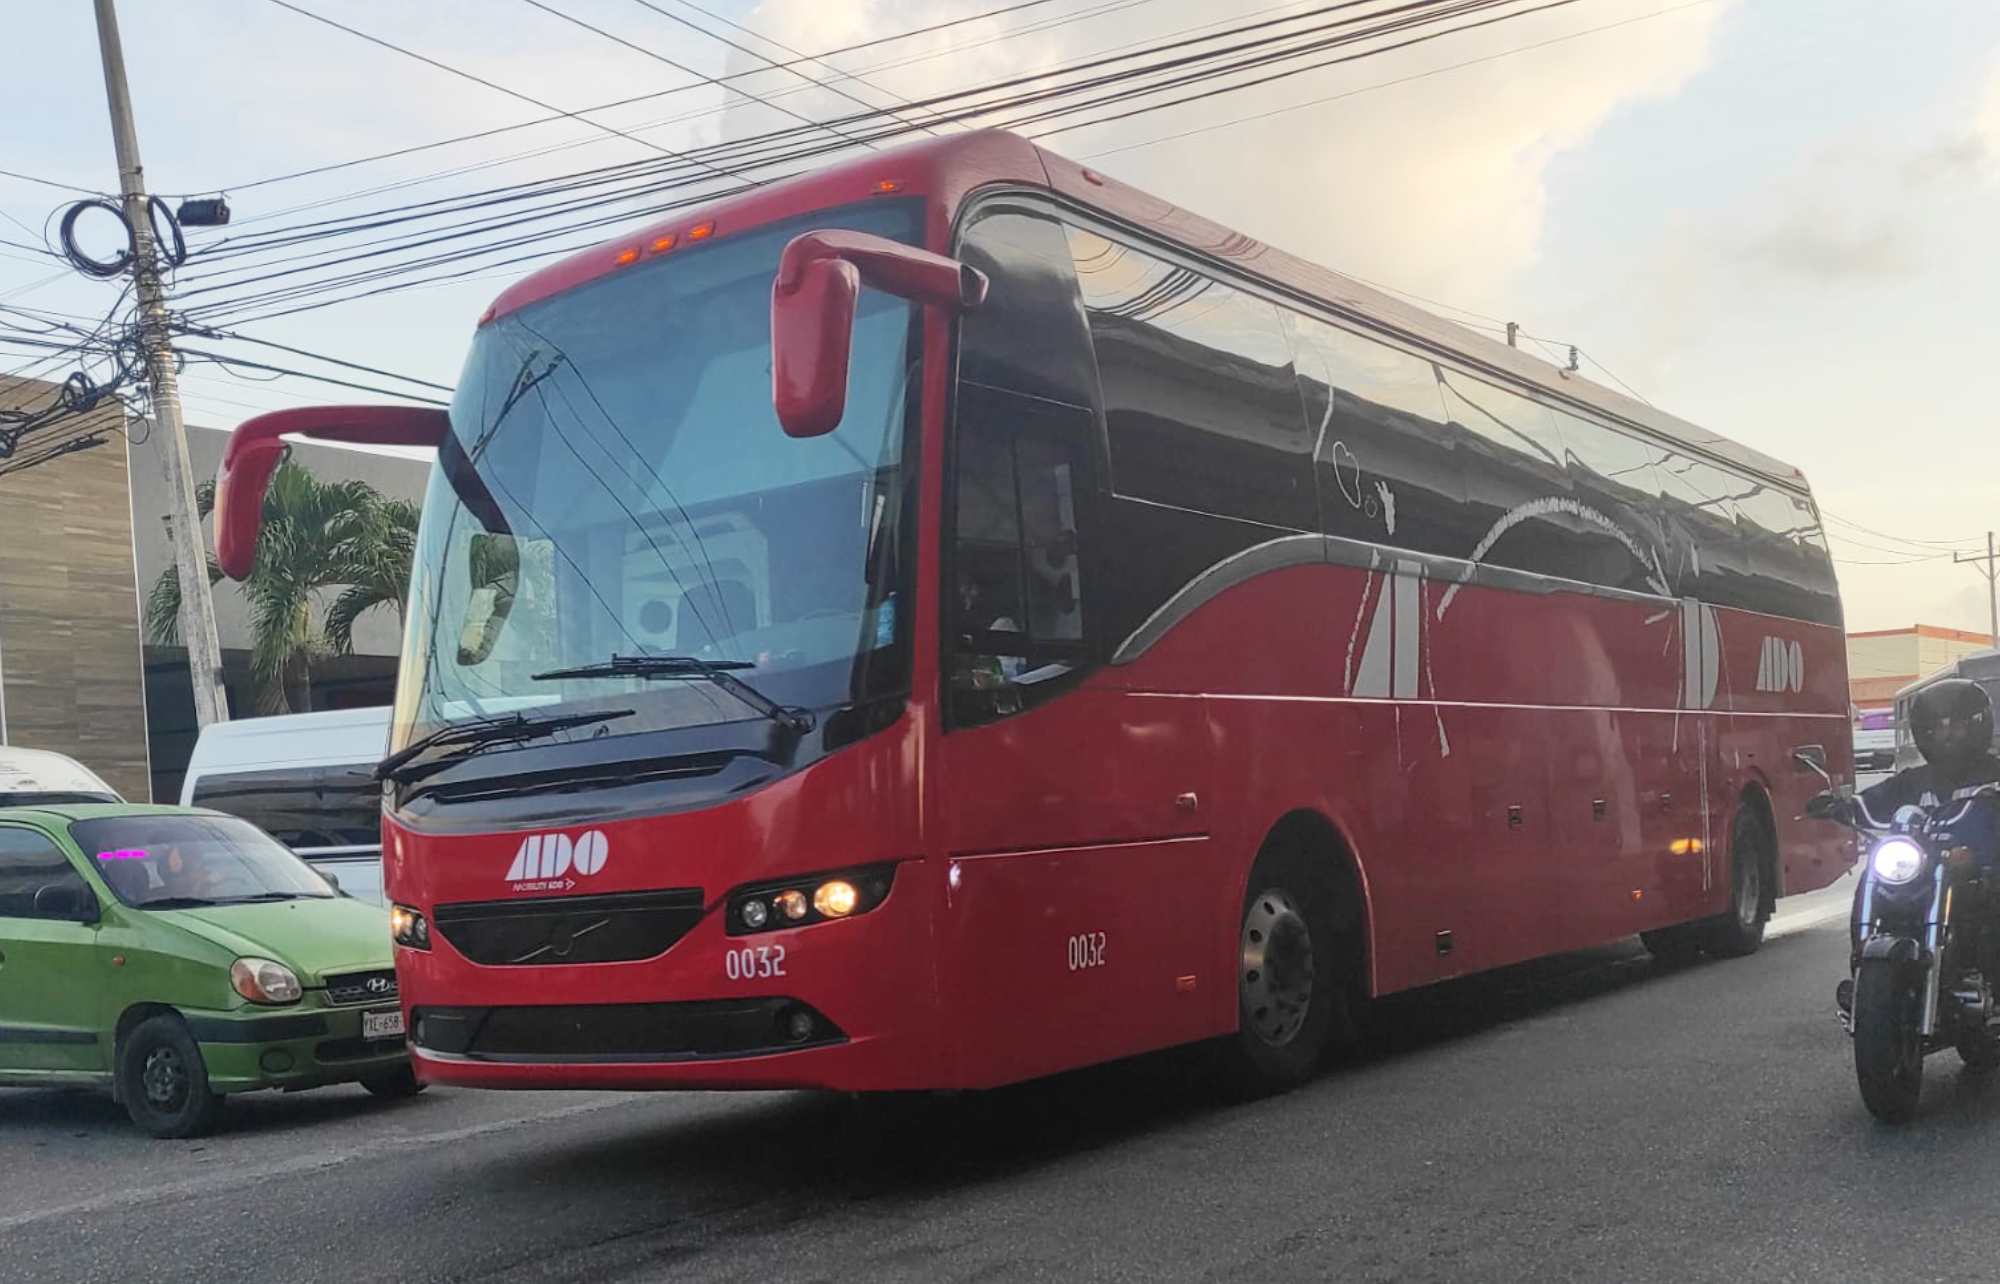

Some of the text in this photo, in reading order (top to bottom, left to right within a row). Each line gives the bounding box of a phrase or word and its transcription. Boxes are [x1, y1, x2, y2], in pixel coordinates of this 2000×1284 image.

[1755, 635, 1804, 693] ADO
[505, 830, 609, 881] ADO
[726, 944, 787, 980] 0032
[1068, 931, 1106, 971] 0032
